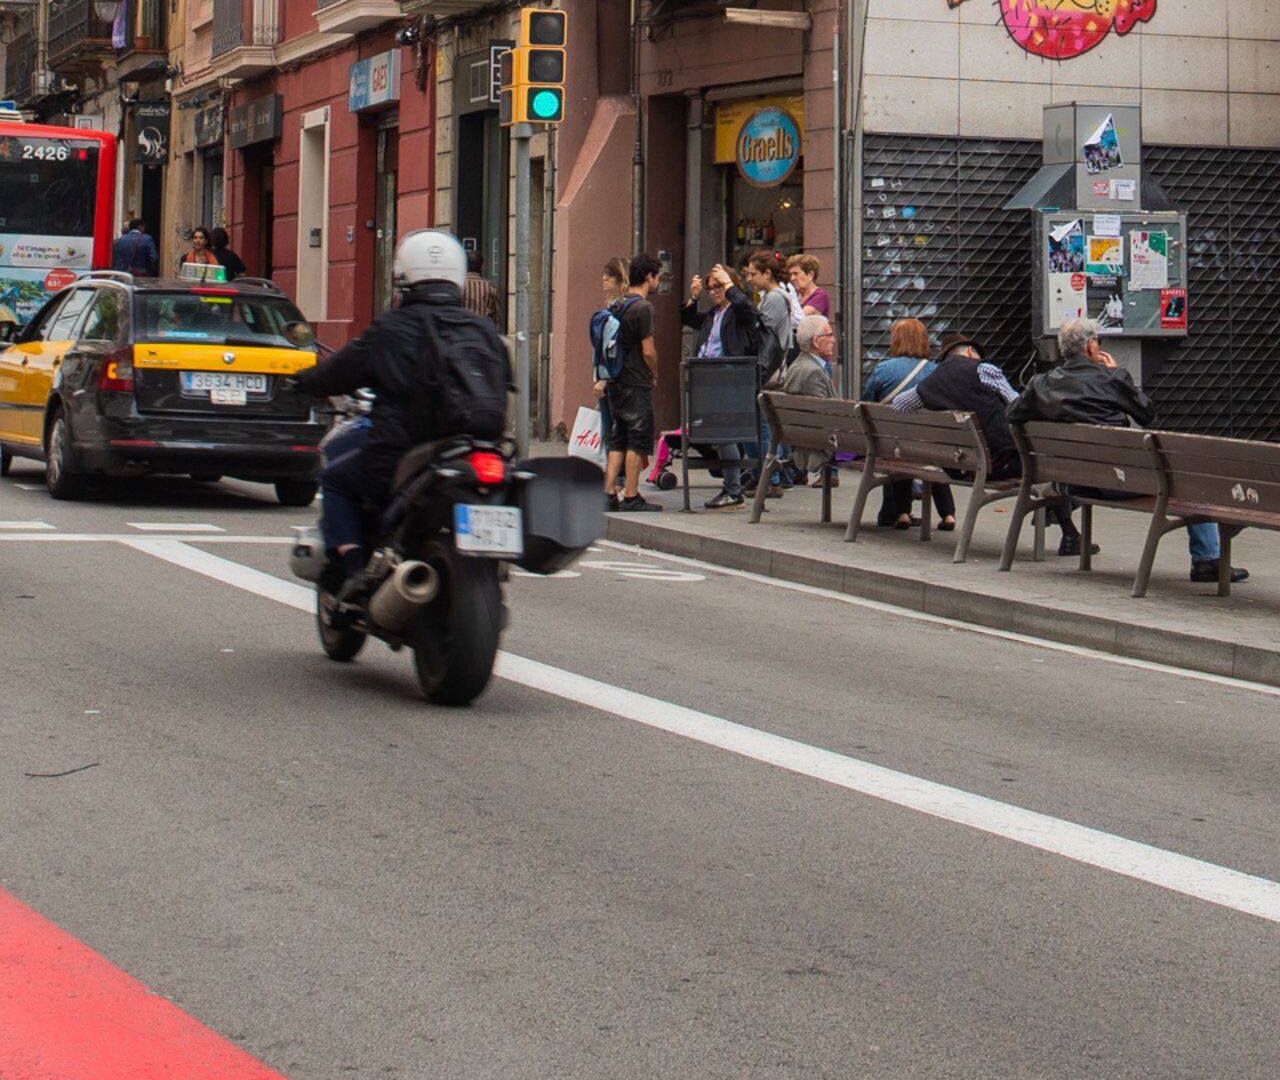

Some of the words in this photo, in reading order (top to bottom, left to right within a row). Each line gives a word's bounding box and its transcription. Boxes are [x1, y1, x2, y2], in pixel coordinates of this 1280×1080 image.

[22, 144, 68, 161] 2426
[195, 374, 232, 388] 3634
[237, 376, 263, 390] HCD
[216, 390, 241, 403] SP
